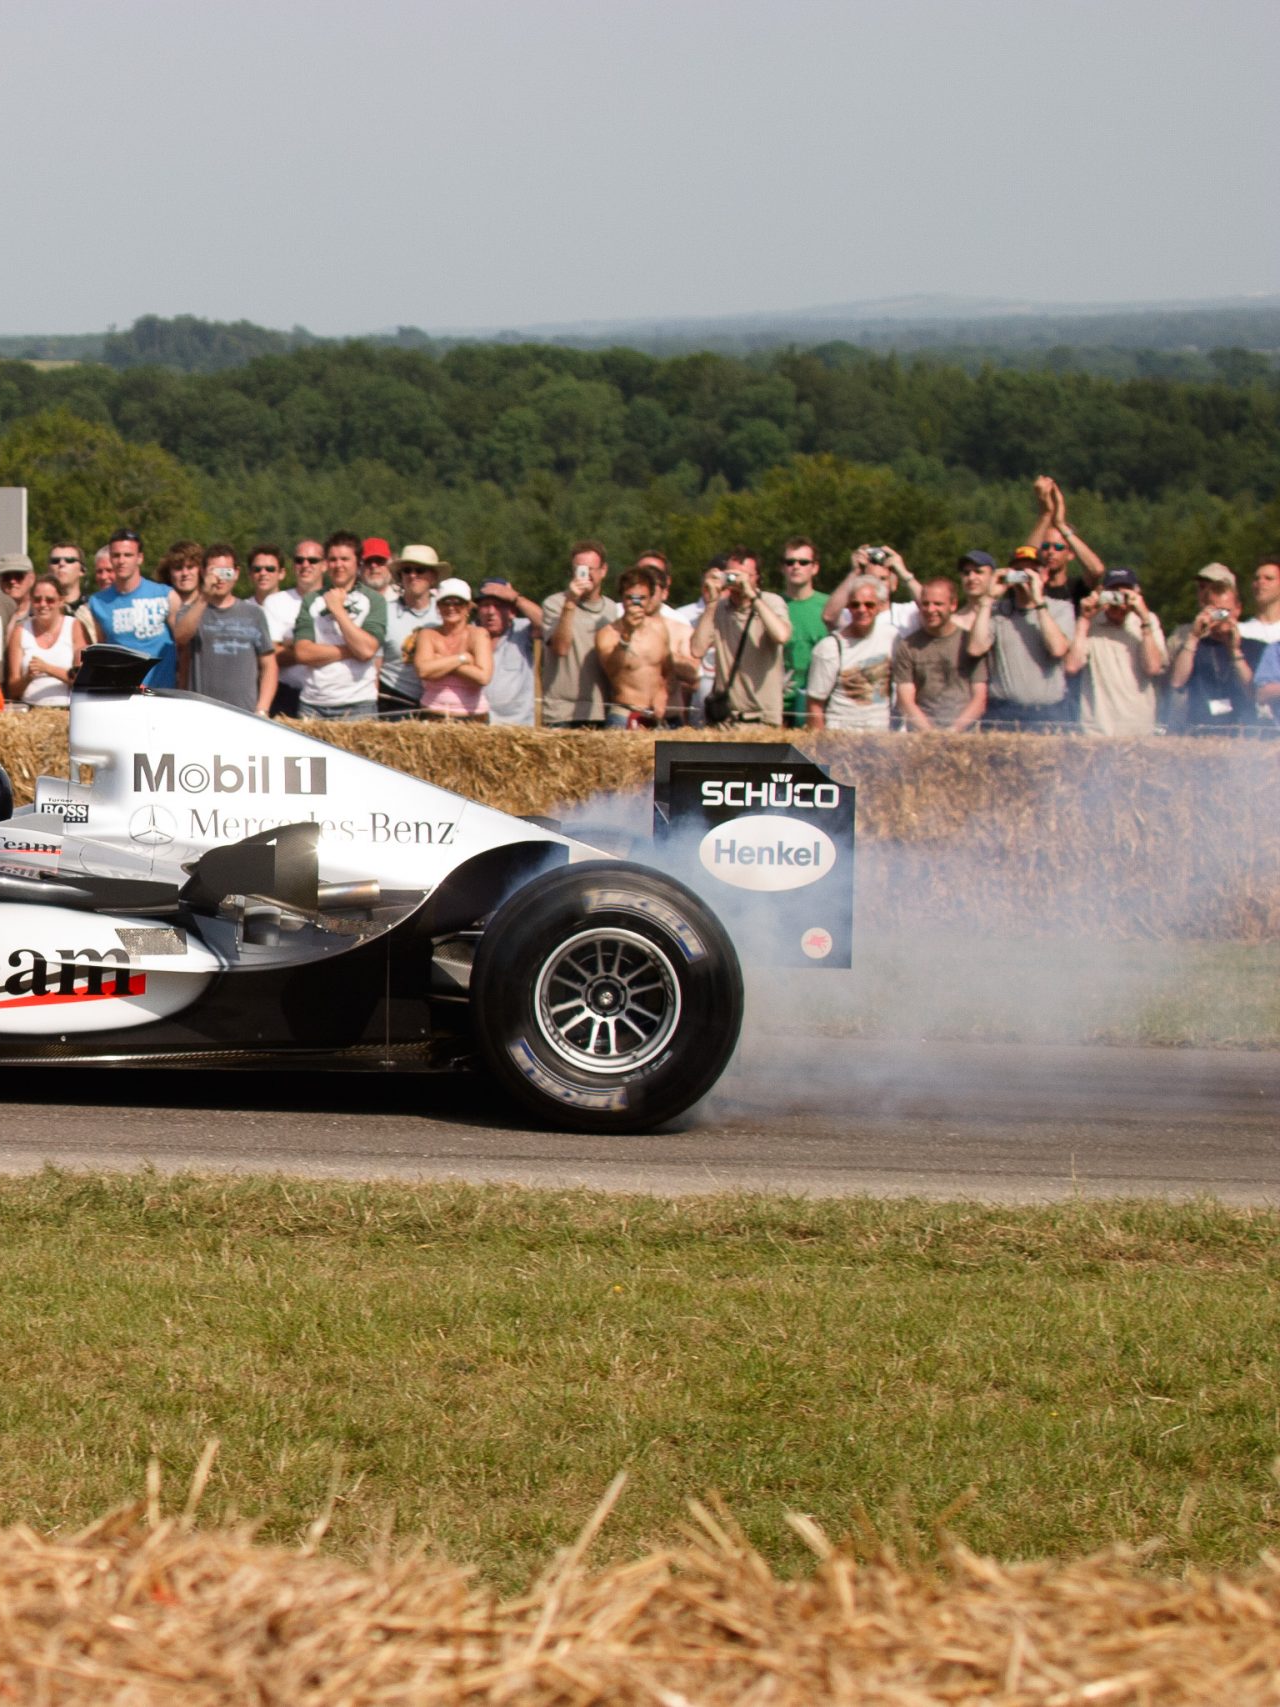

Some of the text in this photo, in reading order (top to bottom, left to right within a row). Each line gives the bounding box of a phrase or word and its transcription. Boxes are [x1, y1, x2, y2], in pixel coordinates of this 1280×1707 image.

[133, 752, 270, 794] Mobil
[701, 773, 840, 808] SCHÜCO
[42, 804, 88, 818] BOSS
[189, 808, 455, 845] Merces-Benz
[714, 839, 821, 866] Henkel
